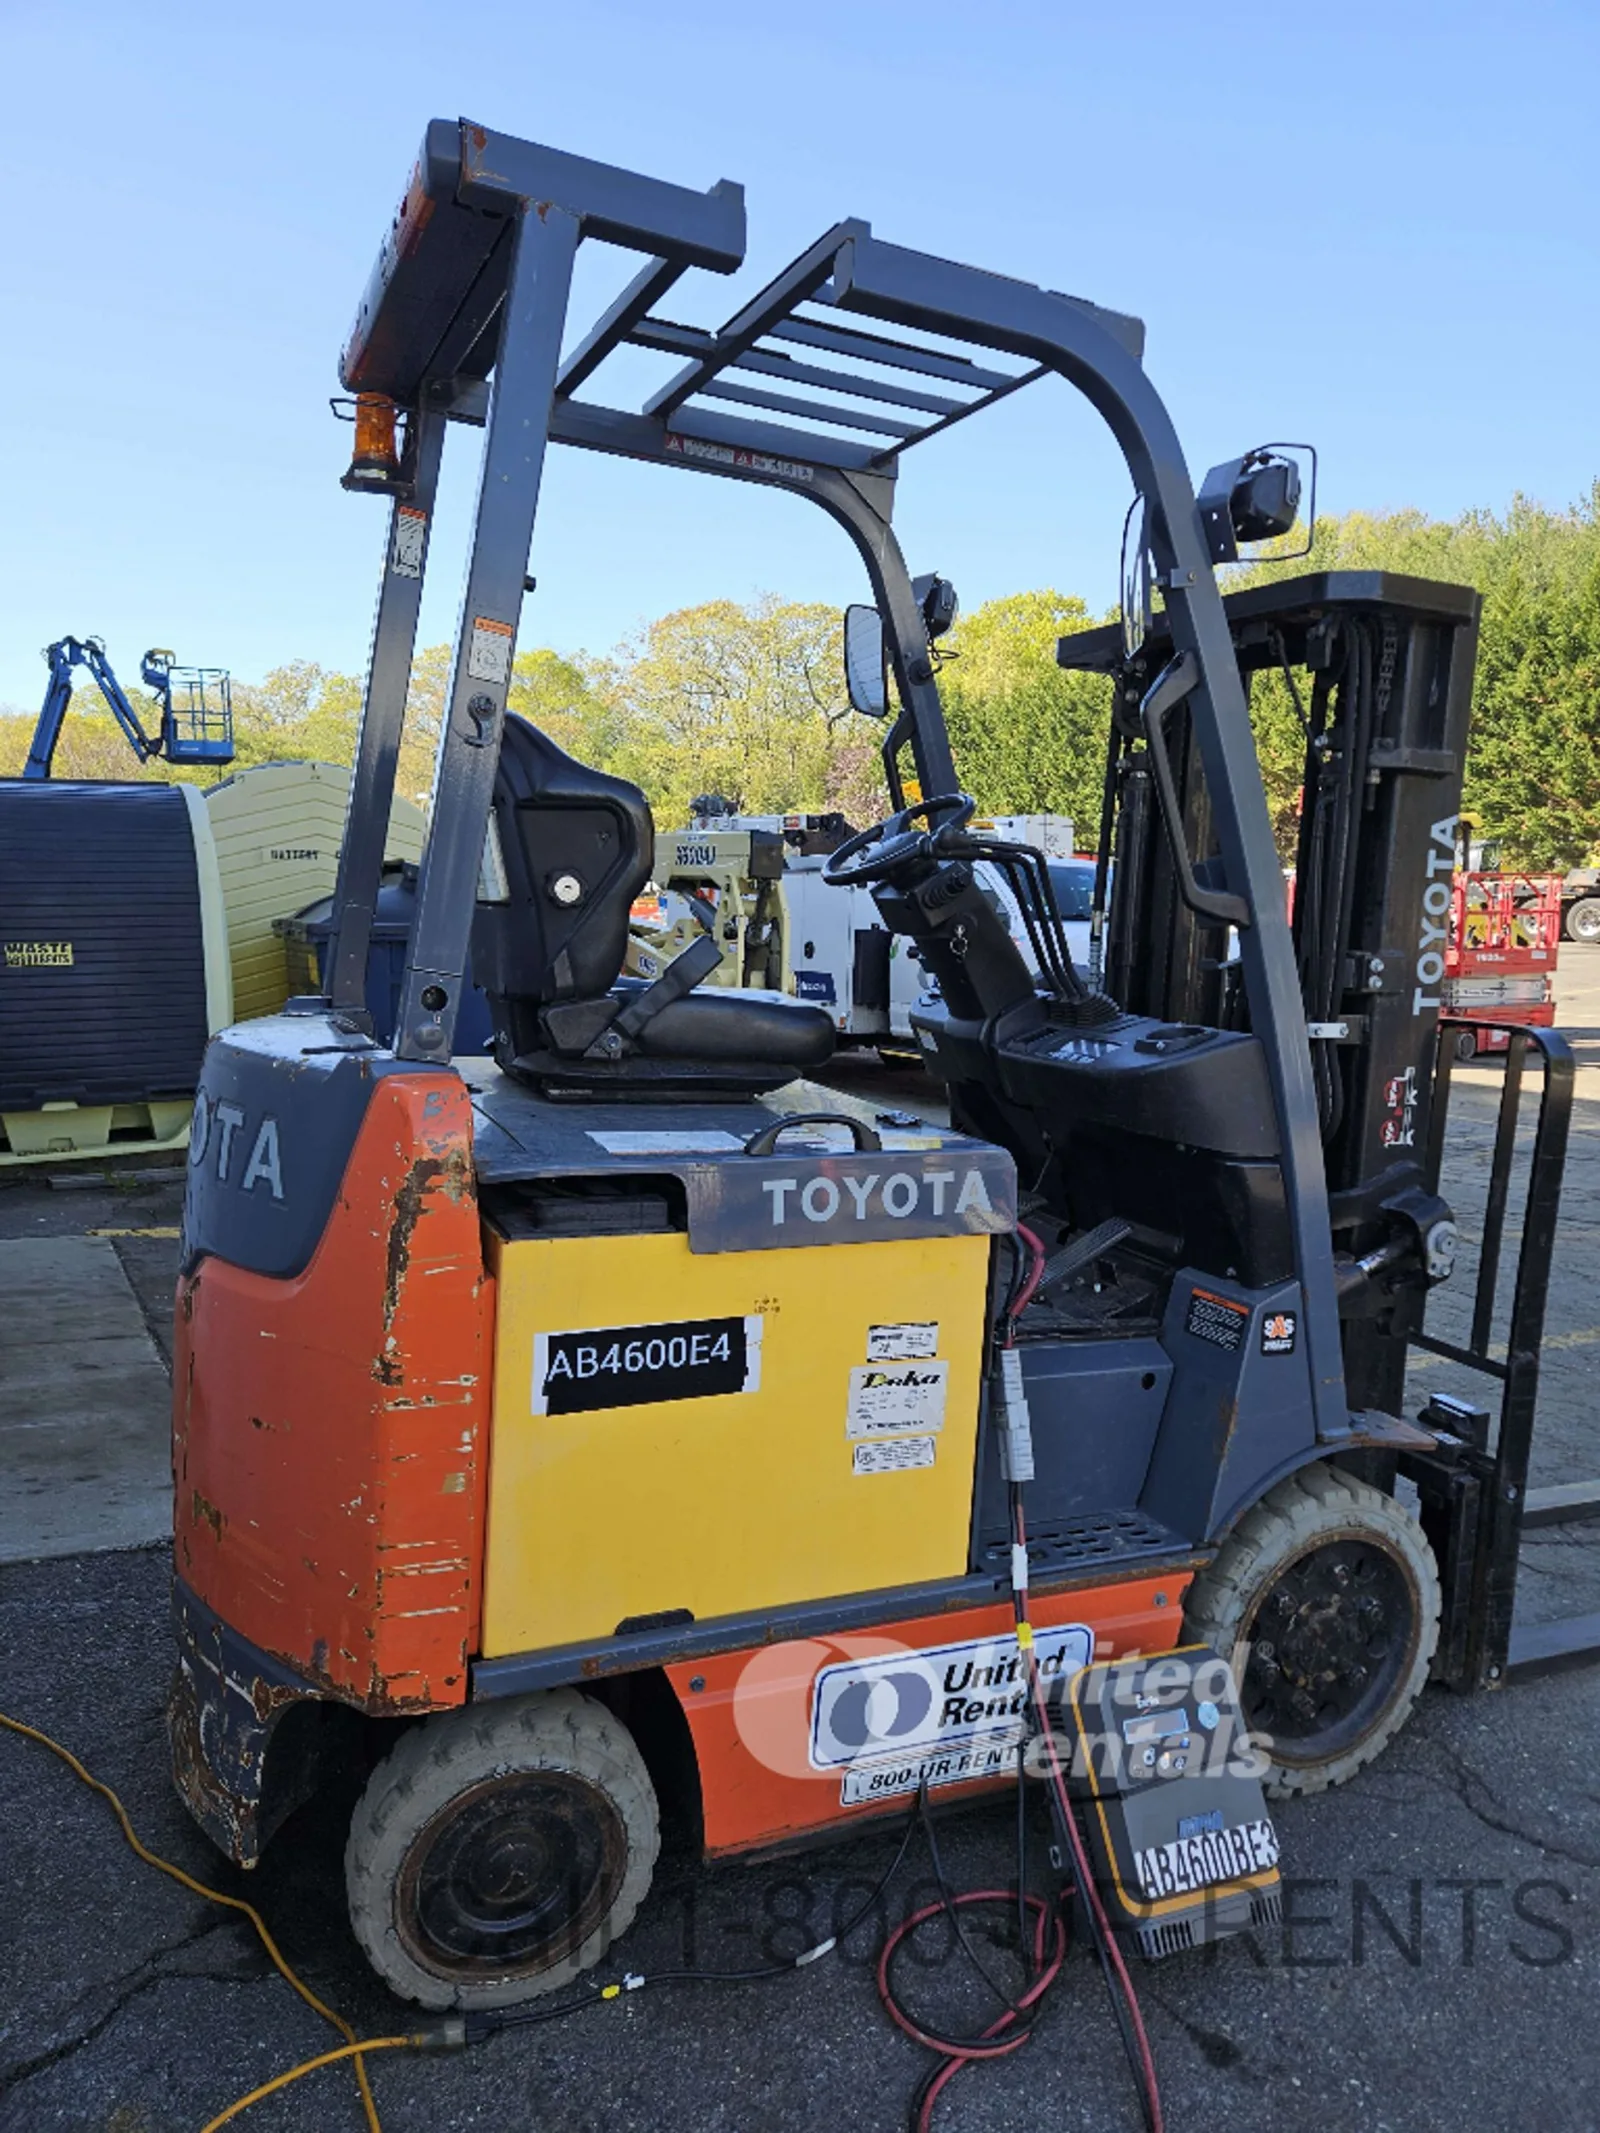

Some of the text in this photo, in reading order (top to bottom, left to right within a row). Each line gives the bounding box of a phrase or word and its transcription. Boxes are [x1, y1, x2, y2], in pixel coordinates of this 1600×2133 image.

[1413, 814, 1460, 1016] TOYOTA
[6, 941, 69, 954] WASTE
[762, 1170, 994, 1226] TOYOTA
[547, 1332, 731, 1383] AB4600E4
